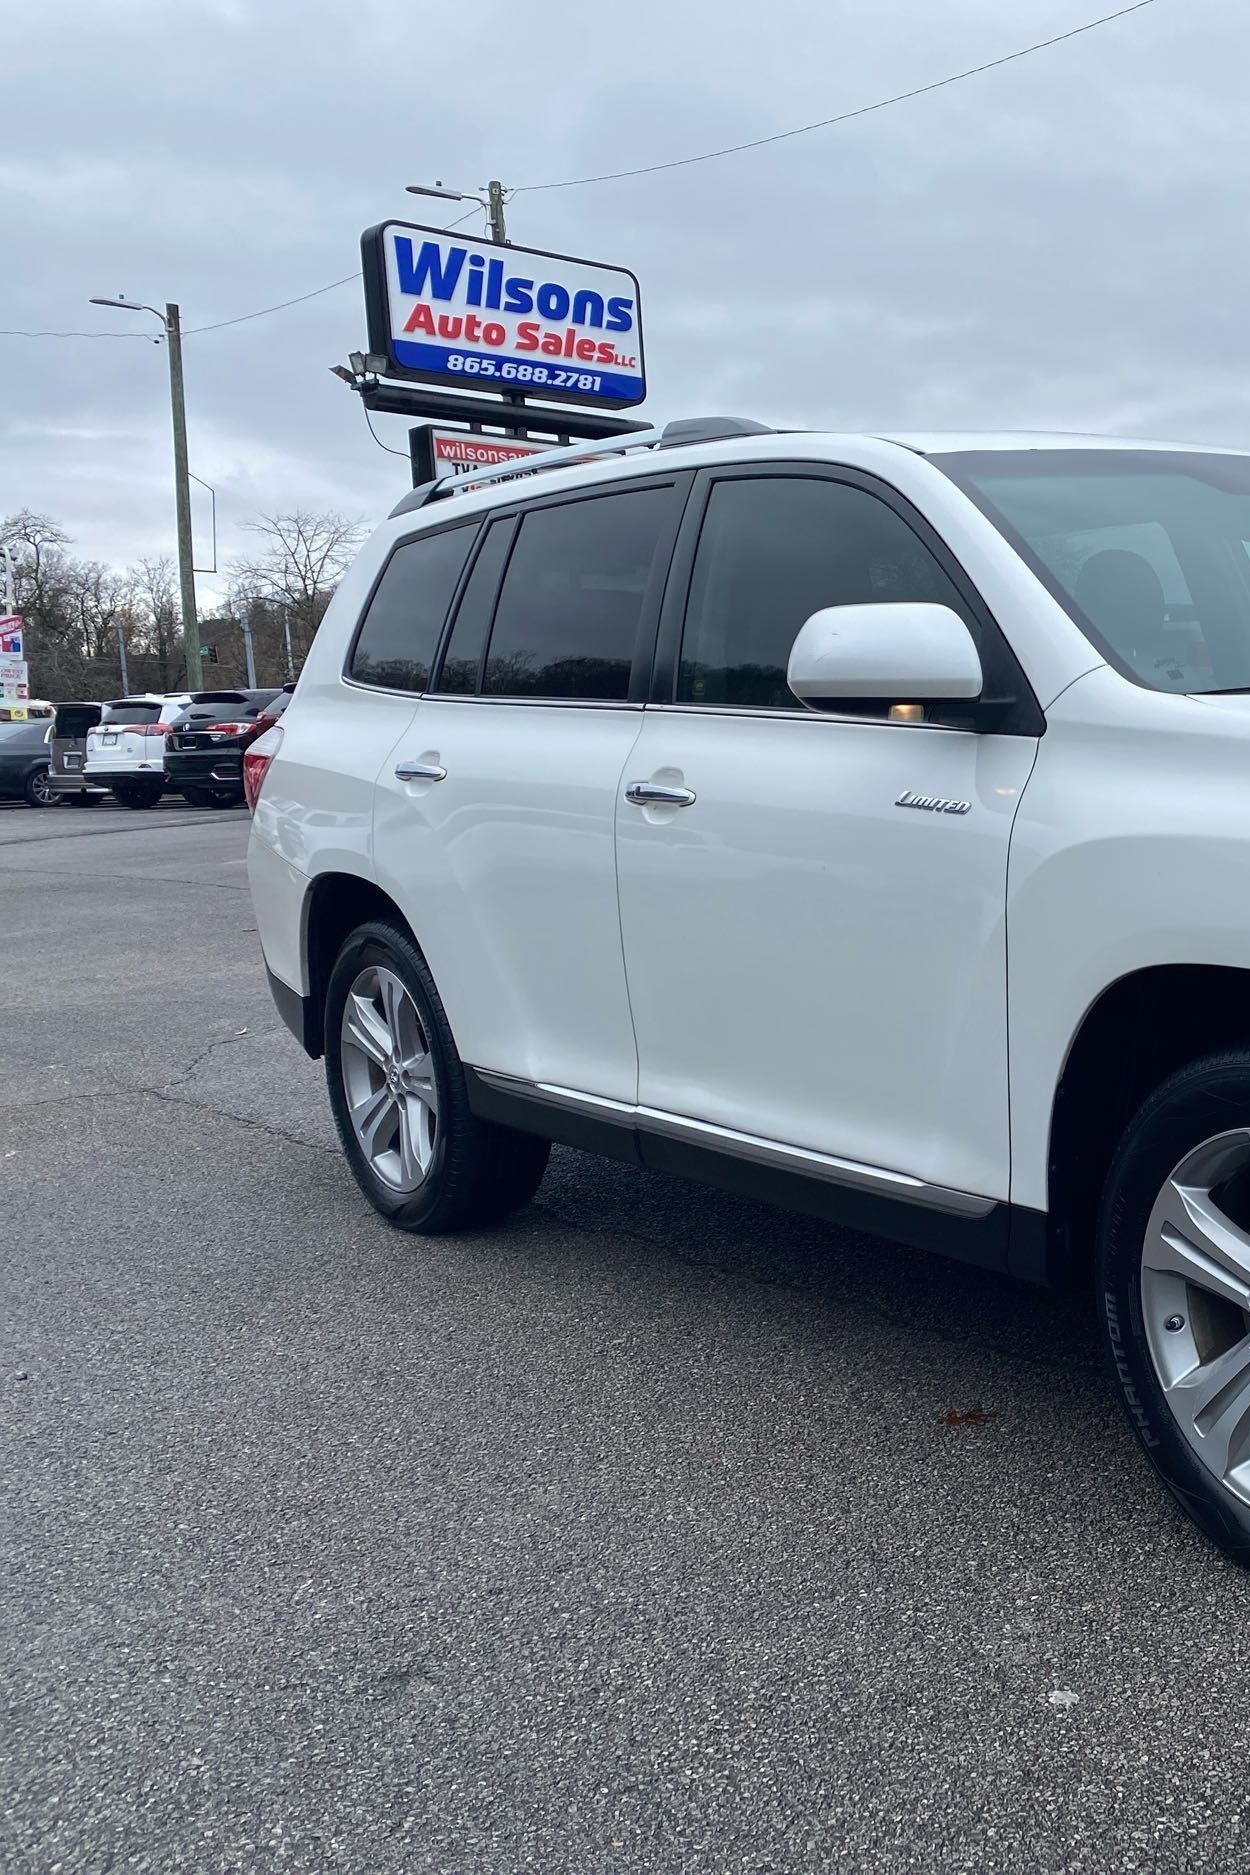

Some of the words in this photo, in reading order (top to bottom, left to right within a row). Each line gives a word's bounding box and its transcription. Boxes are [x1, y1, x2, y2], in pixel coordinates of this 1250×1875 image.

[393, 235, 634, 332] Wilsons
[402, 303, 506, 346] Auto
[514, 321, 616, 364] Sales
[613, 353, 636, 368] LLC
[446, 354, 602, 392] 865.688.2781
[440, 443, 534, 462] wilsonsa
